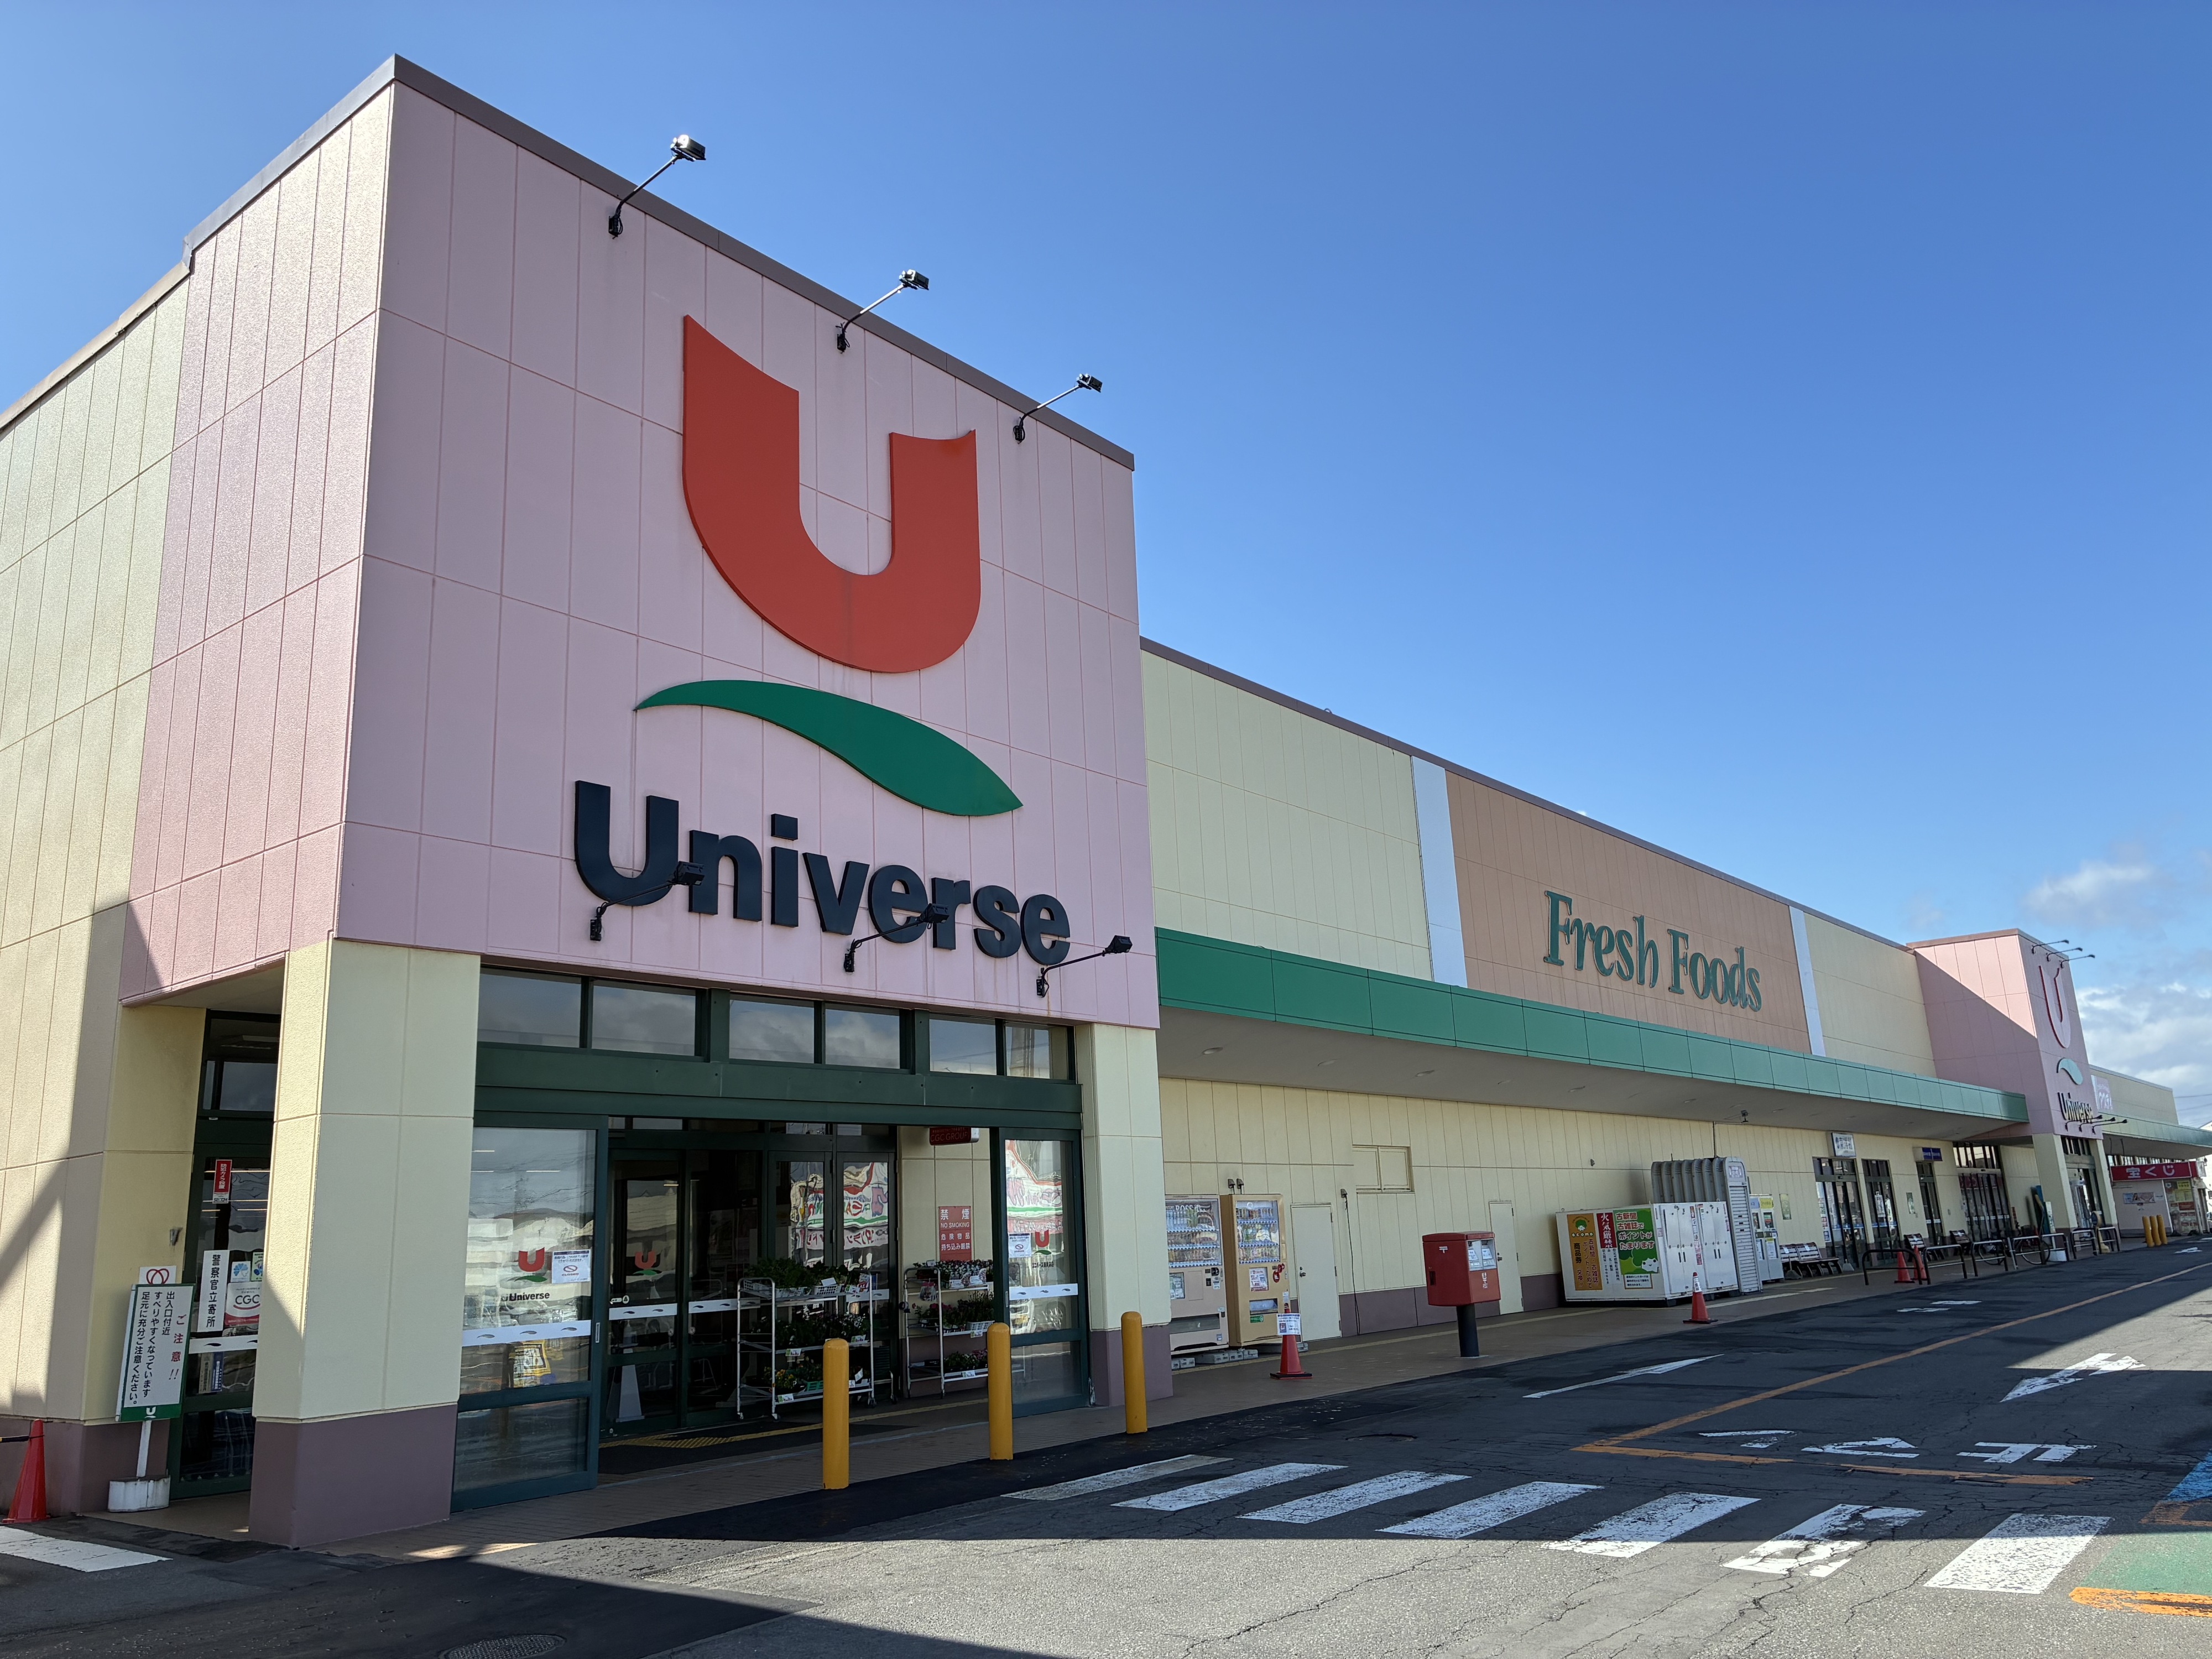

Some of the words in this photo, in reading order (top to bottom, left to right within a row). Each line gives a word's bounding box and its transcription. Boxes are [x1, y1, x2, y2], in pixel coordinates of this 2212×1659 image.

[682, 315, 981, 674] U
[574, 780, 1071, 966] Universe
[1543, 890, 1659, 988] Fresh
[1667, 928, 1762, 1012] Foods
[931, 1134, 945, 1142] CGC
[2126, 1165, 2175, 1178] 宝くじ
[941, 1208, 969, 1220] 禁煙
[1616, 1212, 1637, 1220] 古新聞
[1600, 1213, 1613, 1248] 火気厳禁
[1617, 1222, 1644, 1230] 古雑誌で
[1619, 1232, 1652, 1240] ポイントが
[1574, 1243, 1582, 1264] 商品券
[1620, 1241, 1655, 1250] たまります
[206, 1254, 221, 1328] 警察官立寄所
[509, 1292, 550, 1301] Universe
[235, 1295, 260, 1305] CGC
[162, 1291, 175, 1335] 出入口付近
[129, 1291, 150, 1405] 足元に充分ご注意ください。
[143, 1291, 163, 1398] すべりやすくなっています
